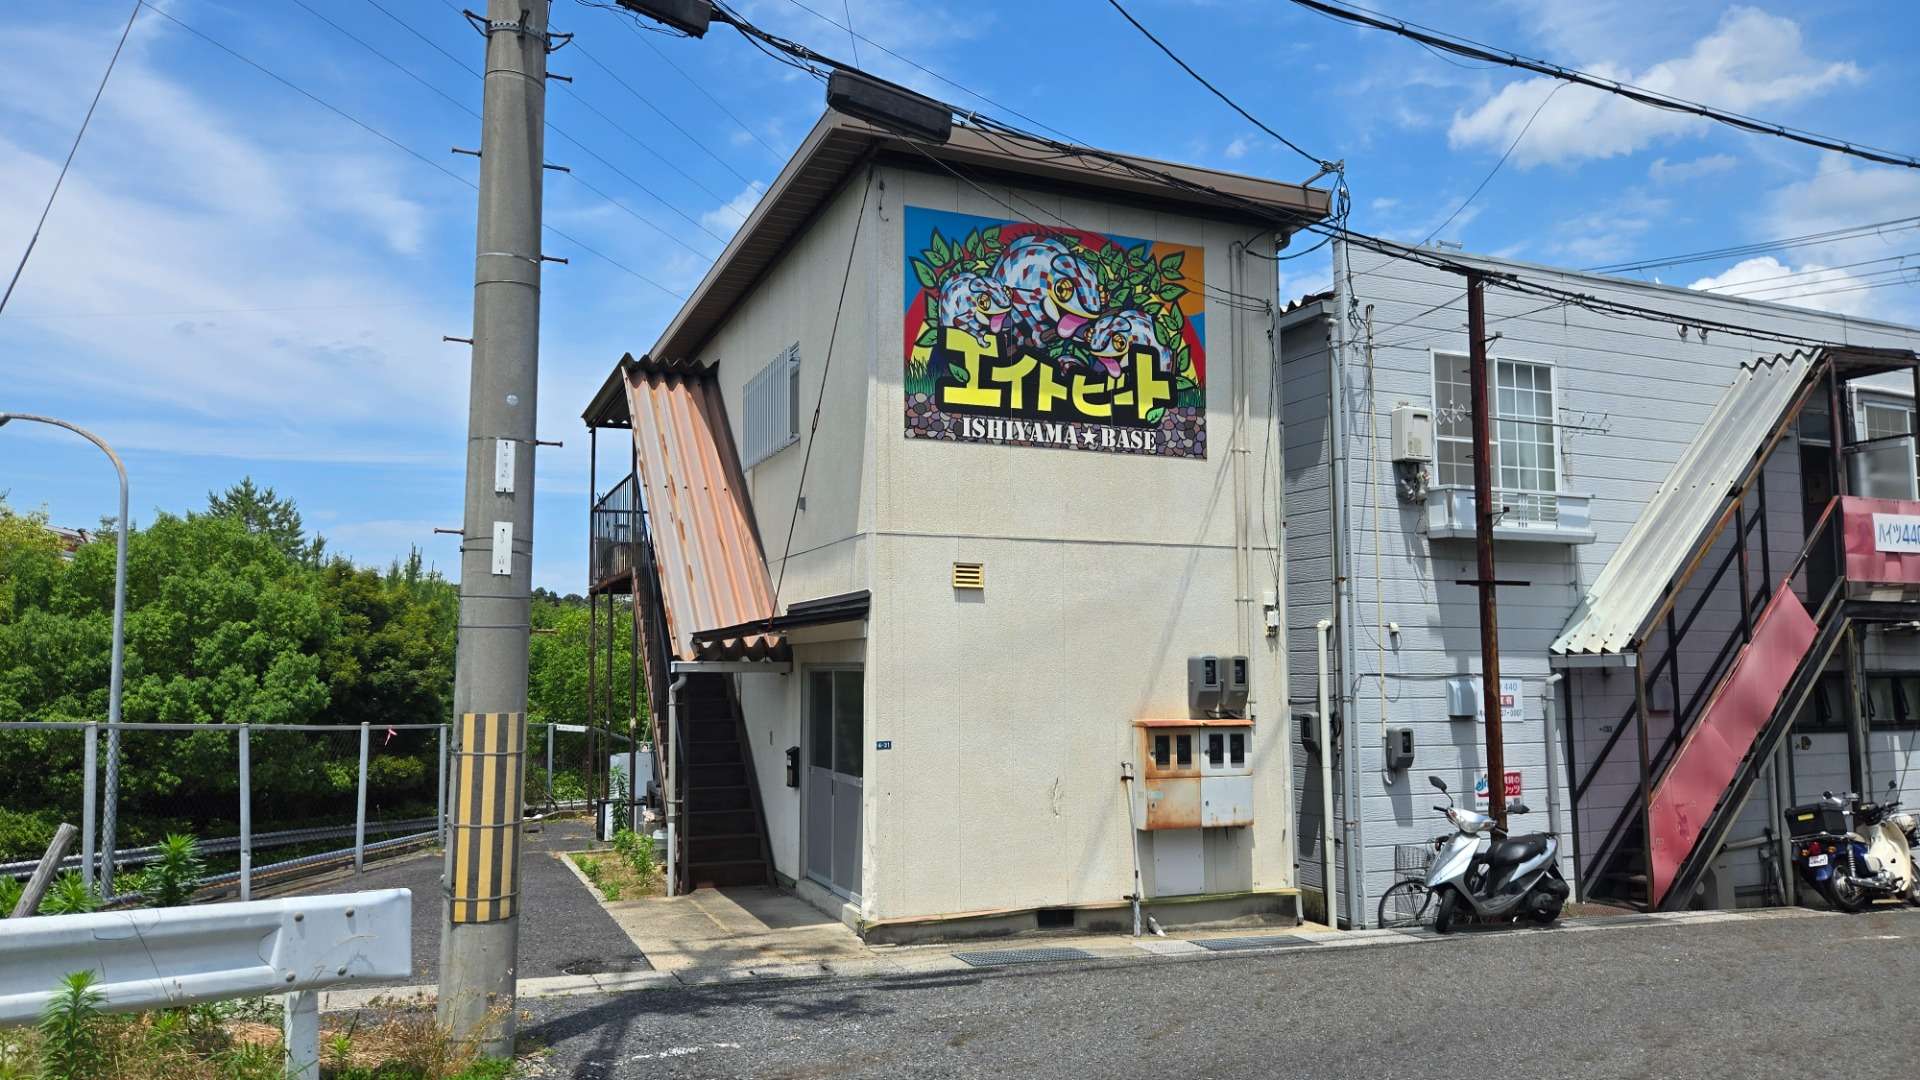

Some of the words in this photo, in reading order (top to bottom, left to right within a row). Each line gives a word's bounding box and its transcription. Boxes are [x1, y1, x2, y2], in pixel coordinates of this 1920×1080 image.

[943, 327, 1170, 420] エイトビート
[962, 416, 1079, 445] ISHIYAMA
[1101, 427, 1157, 451] BASE
